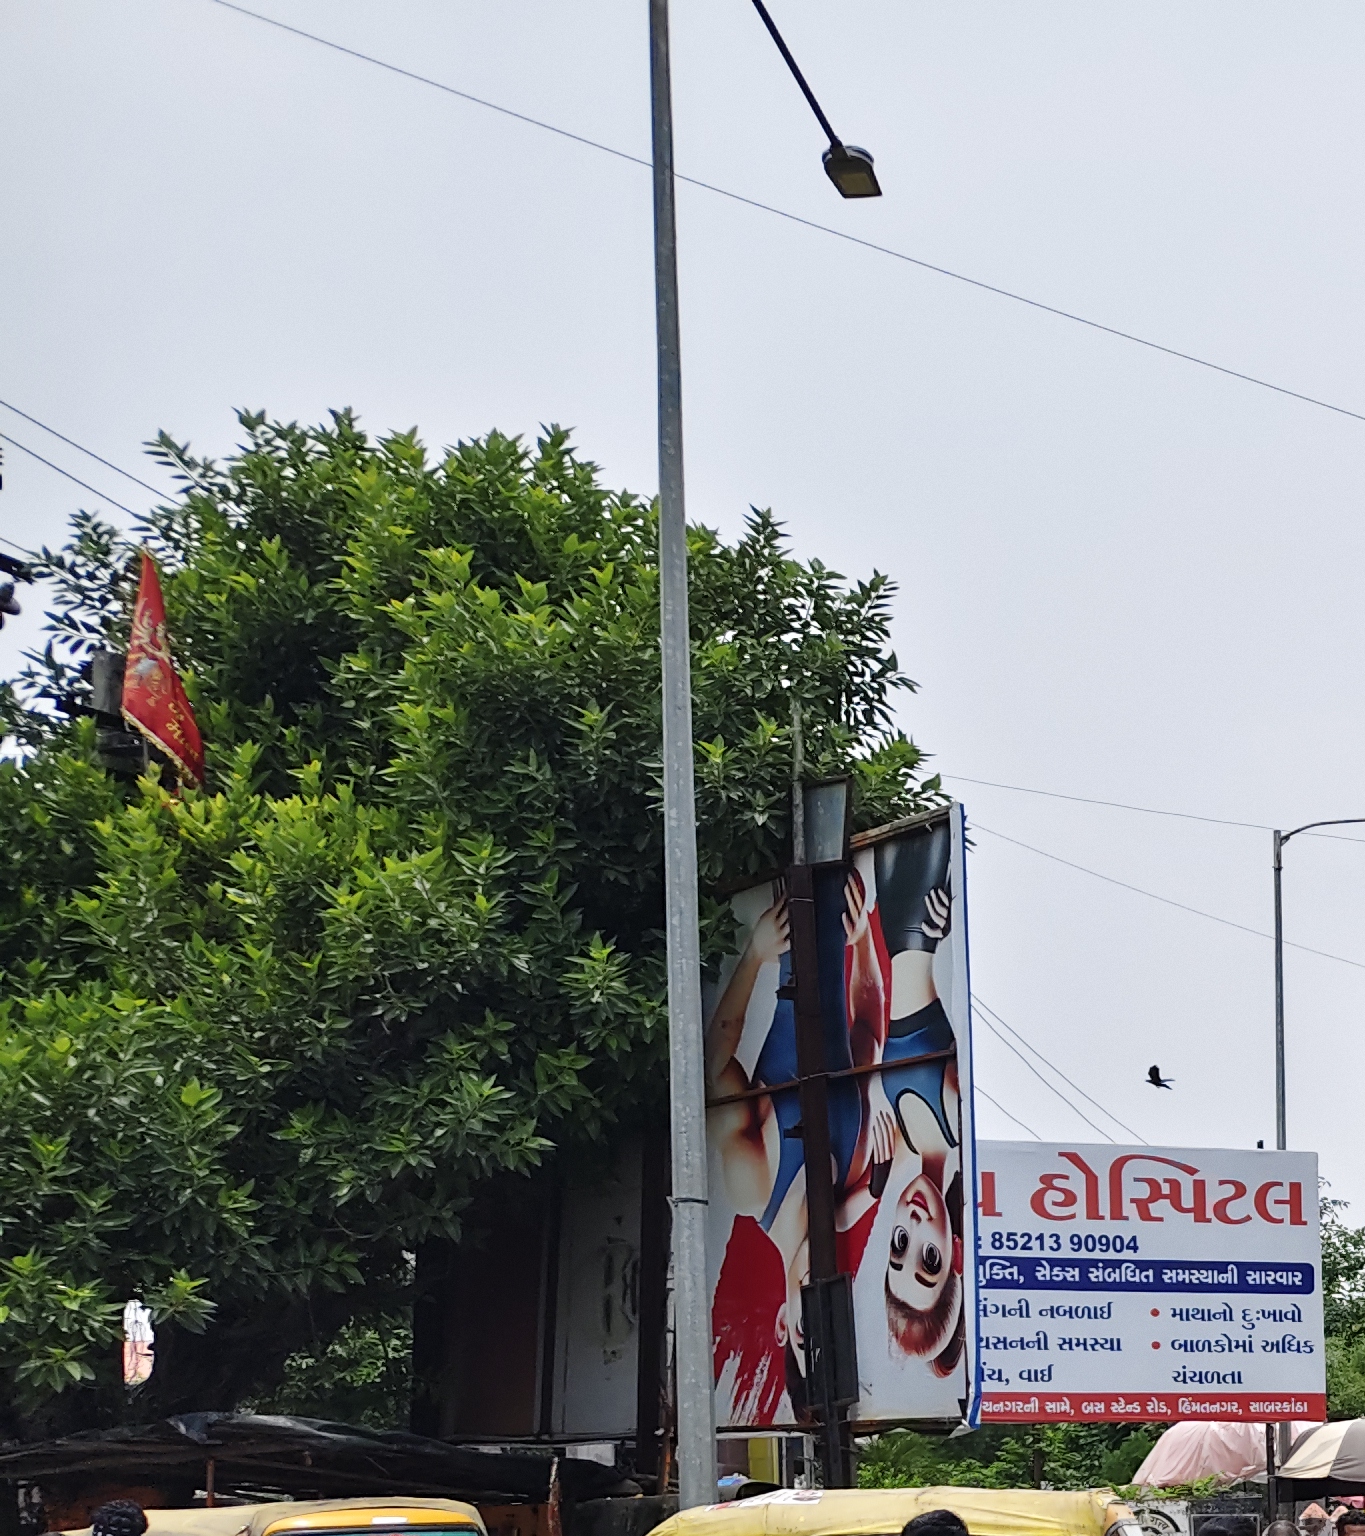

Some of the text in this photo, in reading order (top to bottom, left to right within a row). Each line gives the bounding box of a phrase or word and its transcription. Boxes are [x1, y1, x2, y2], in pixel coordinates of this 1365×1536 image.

[1029, 1152, 1308, 1226] હોસ્પિટલ
[991, 1232, 1140, 1254] 85213 90904
[1035, 1261, 1080, 1283] સેક્સ
[1162, 1264, 1239, 1286] સમસ્યાની
[1246, 1269, 1304, 1286] સારવાર
[1038, 1301, 1114, 1320] નબળાઈ
[1170, 1303, 1235, 1323] માથાનો
[1056, 1335, 1123, 1353] સમસ્યા
[1170, 1334, 1316, 1355] બાળકોમાં અધિક
[1171, 1367, 1244, 1386] ચંચળતા
[1045, 1396, 1075, 1416] સામે,
[1082, 1399, 1106, 1415] બસ
[1111, 1397, 1142, 1415] સ્ટેન્ડ
[1147, 1399, 1173, 1417] રોડ,
[1178, 1397, 1244, 1417] હિંમતનગર,
[1249, 1399, 1309, 1415] સાબરકાંઠા
